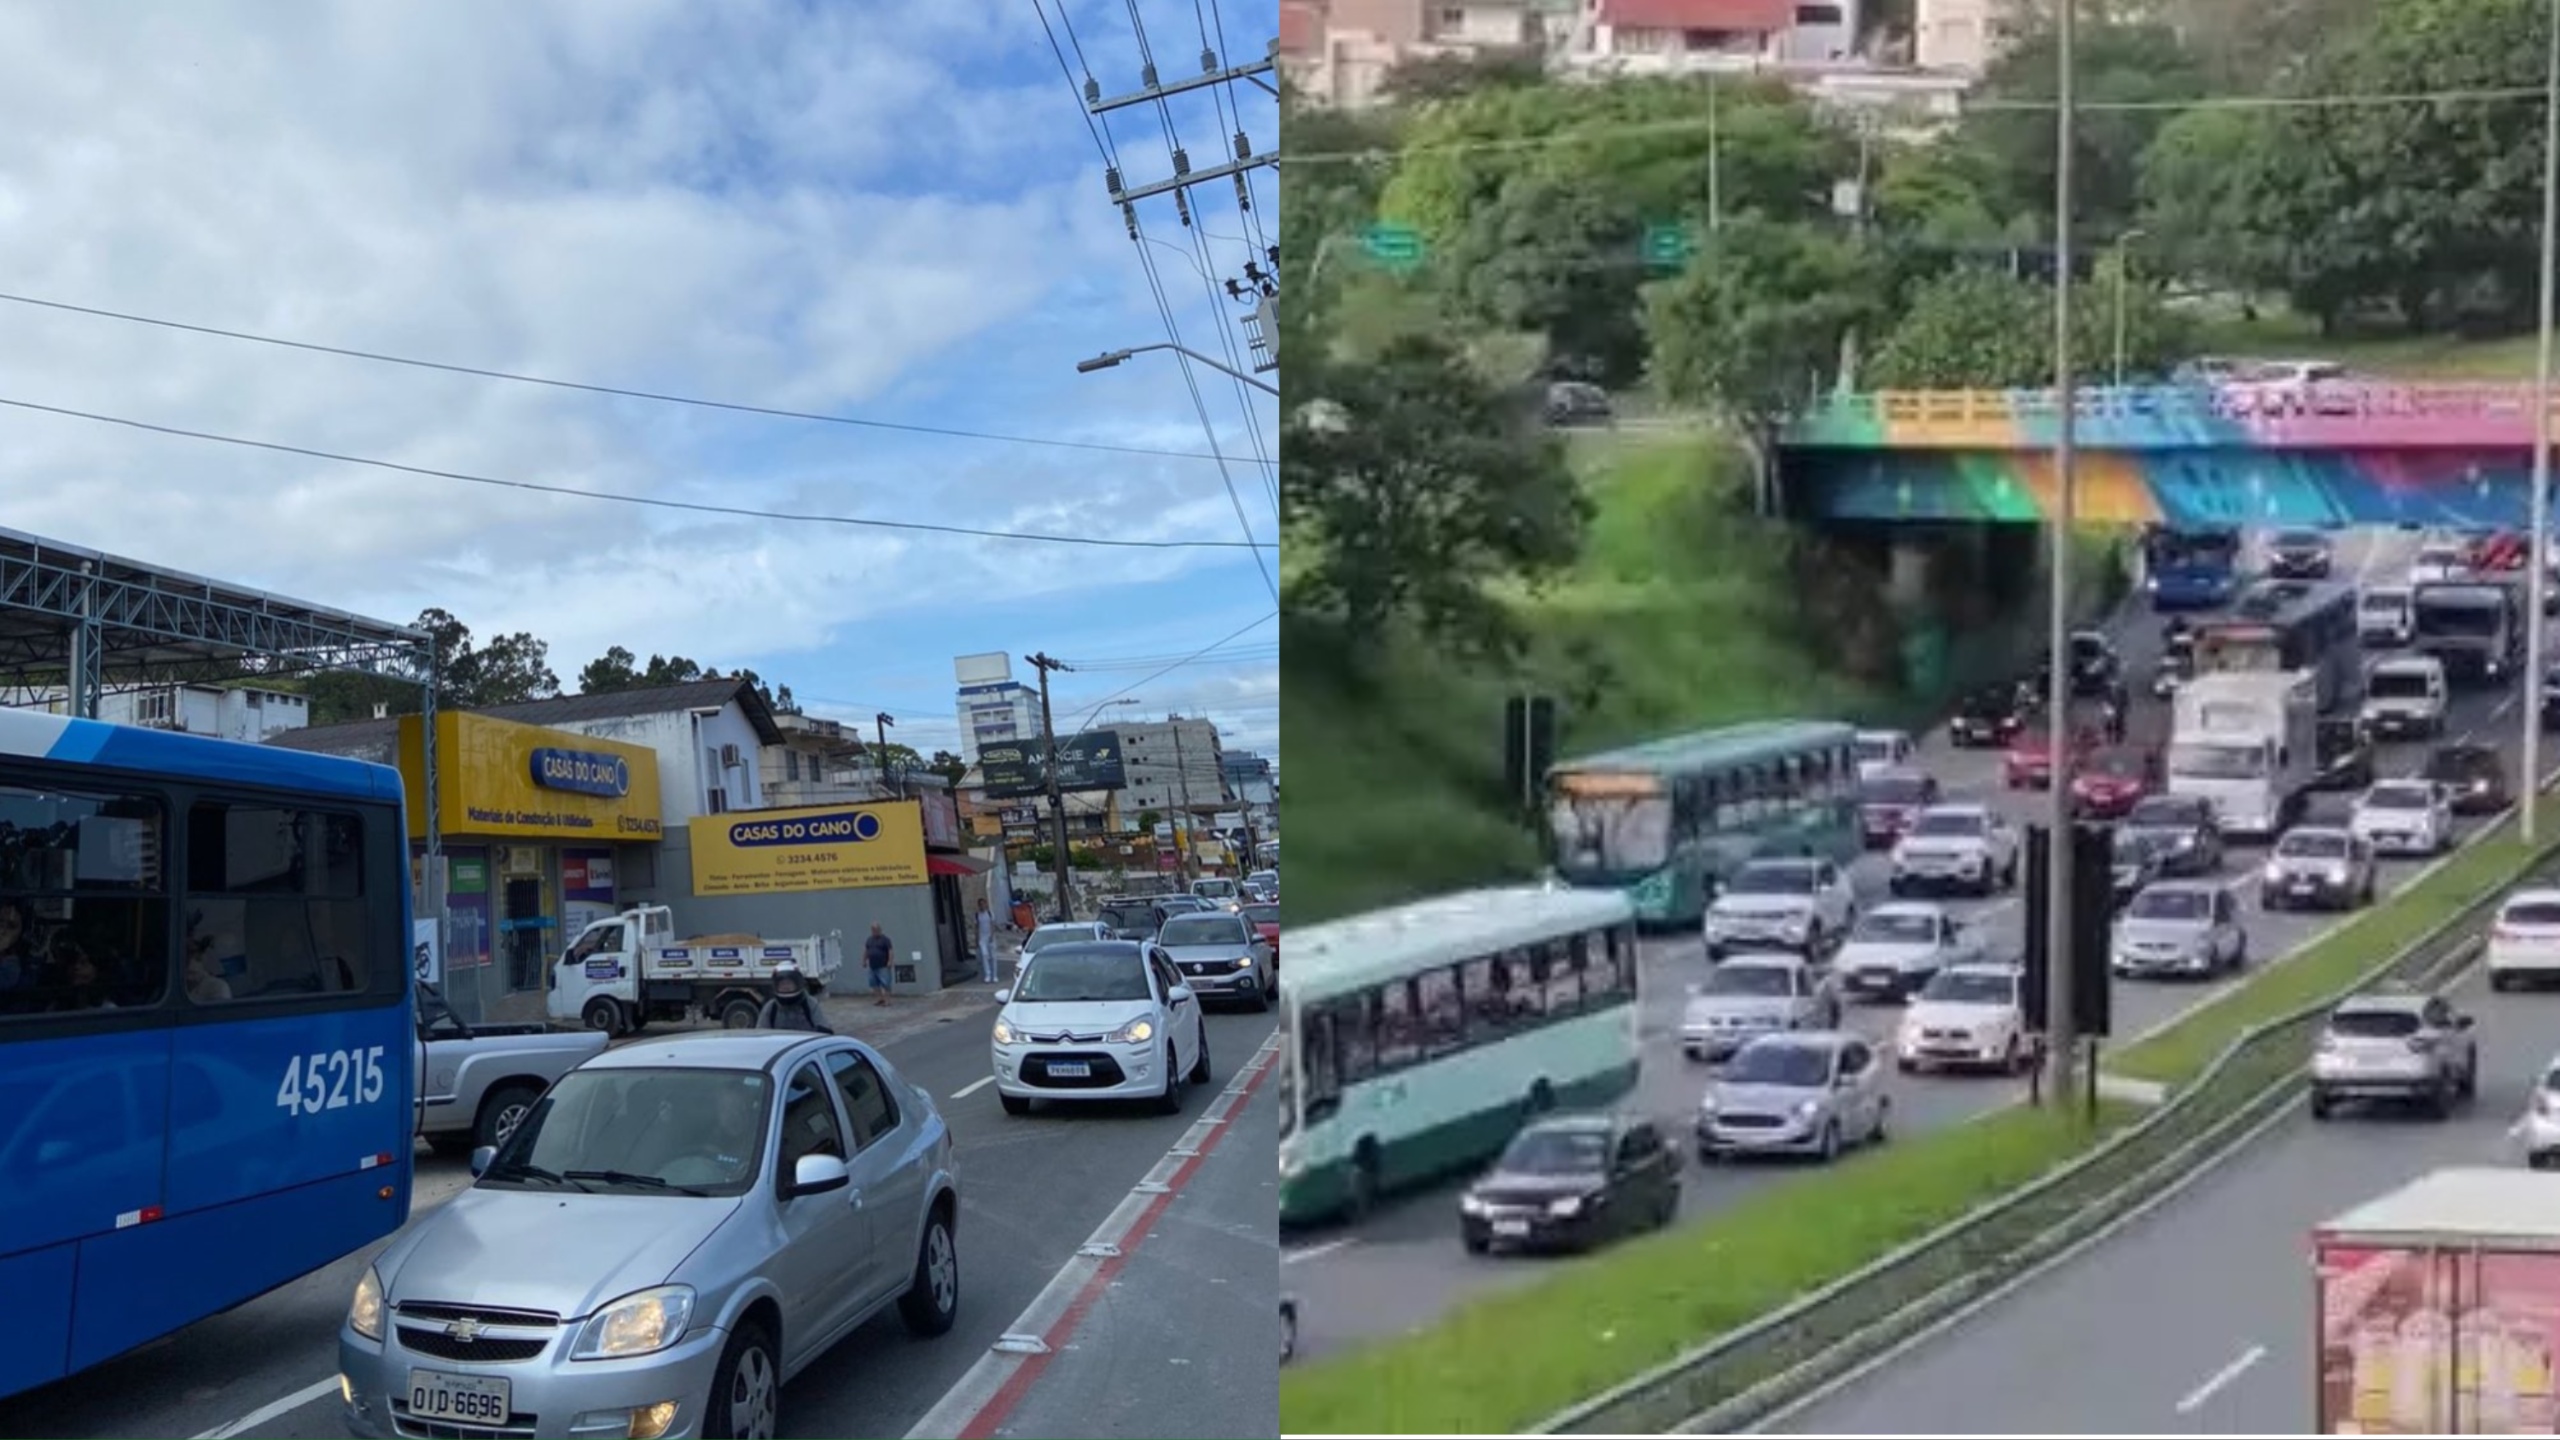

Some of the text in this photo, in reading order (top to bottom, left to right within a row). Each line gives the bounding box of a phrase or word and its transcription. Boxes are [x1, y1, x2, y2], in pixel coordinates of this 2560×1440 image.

[544, 757, 615, 784] CASAS DO CANO
[505, 810, 515, 823] de
[733, 820, 851, 842] CASAS DO CANO
[787, 853, 838, 864] 3234.4576
[277, 1045, 384, 1117] 45215
